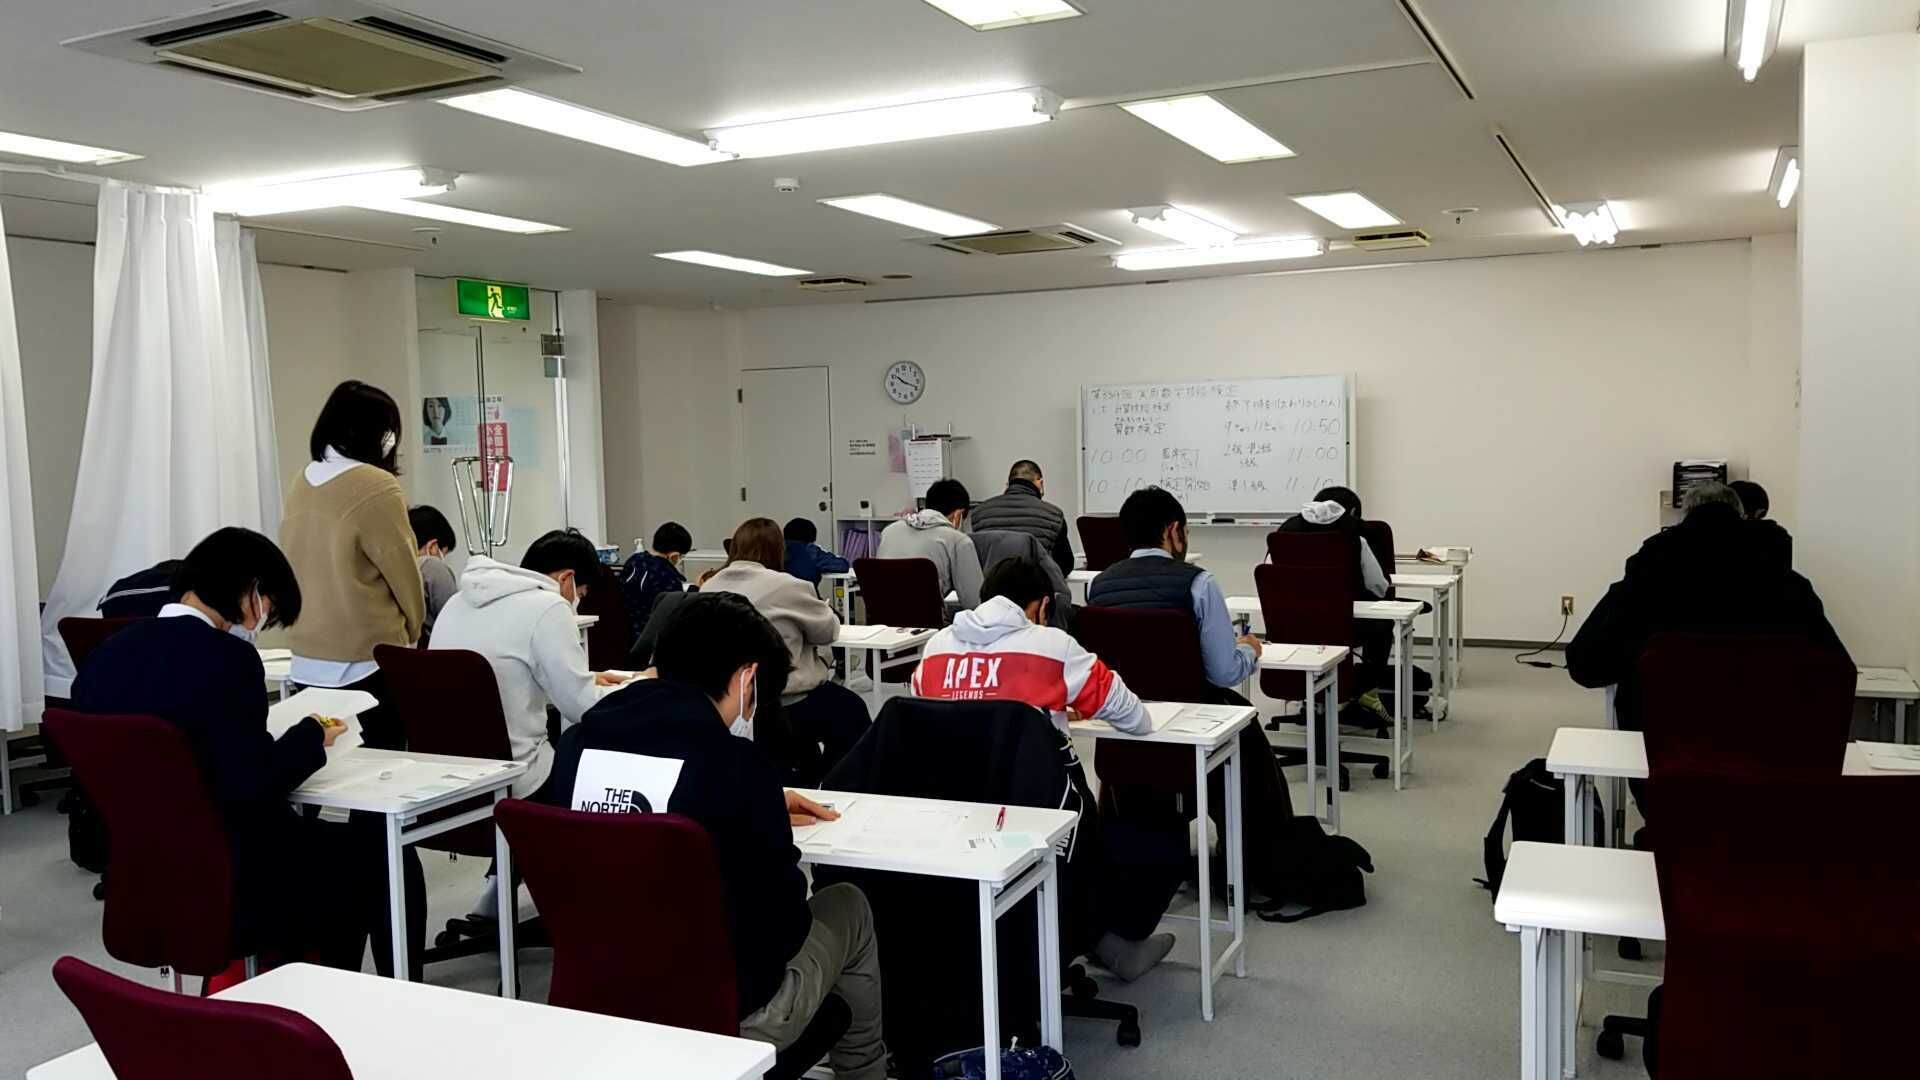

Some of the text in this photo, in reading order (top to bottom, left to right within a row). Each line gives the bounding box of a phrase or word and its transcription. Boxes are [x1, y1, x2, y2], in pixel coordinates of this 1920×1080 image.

[943, 657, 1003, 689] APEX
[951, 690, 984, 700] LEGENDS
[605, 787, 632, 804] THE
[581, 800, 630, 814] NORTH
